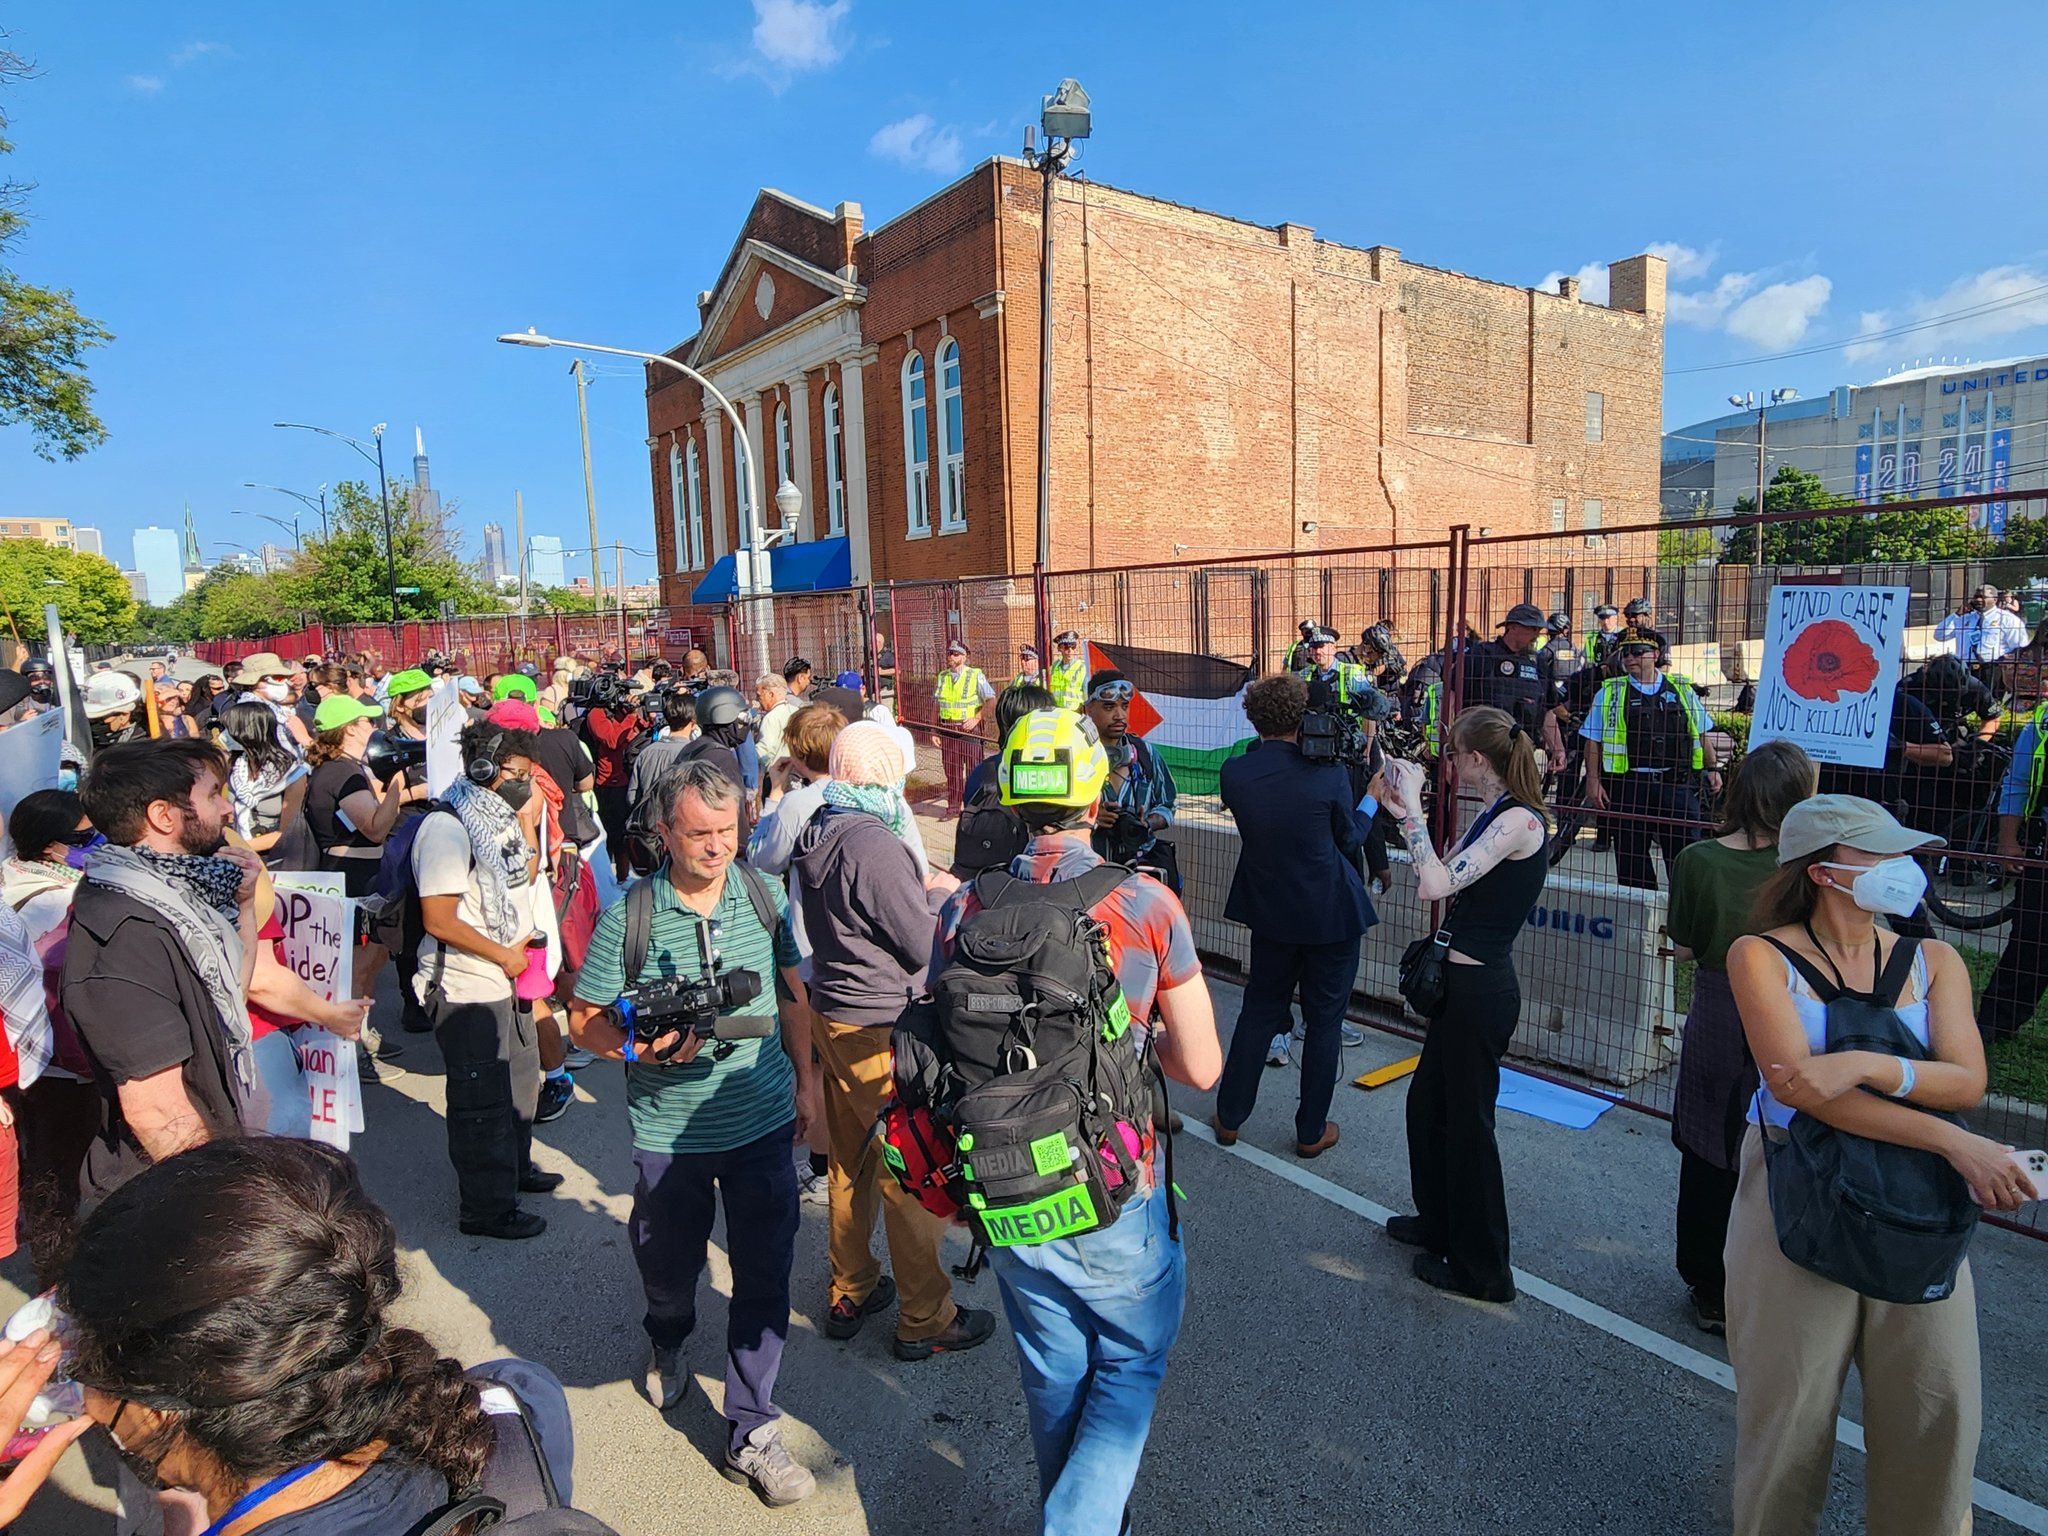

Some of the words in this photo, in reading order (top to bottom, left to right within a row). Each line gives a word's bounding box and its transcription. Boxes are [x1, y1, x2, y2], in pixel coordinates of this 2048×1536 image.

[1943, 368, 2048, 394] UNITED
[1778, 590, 1831, 645] FUND
[1840, 591, 1895, 649] CARE
[1763, 676, 1801, 732] NOT
[1804, 686, 1878, 739] KILLING
[1016, 768, 1065, 790] MEDIA
[275, 892, 312, 939] OP
[309, 916, 342, 948] the
[1526, 905, 1613, 939] ORIG
[971, 1147, 1029, 1177] MEDIA
[986, 1195, 1091, 1241] MEDIA
